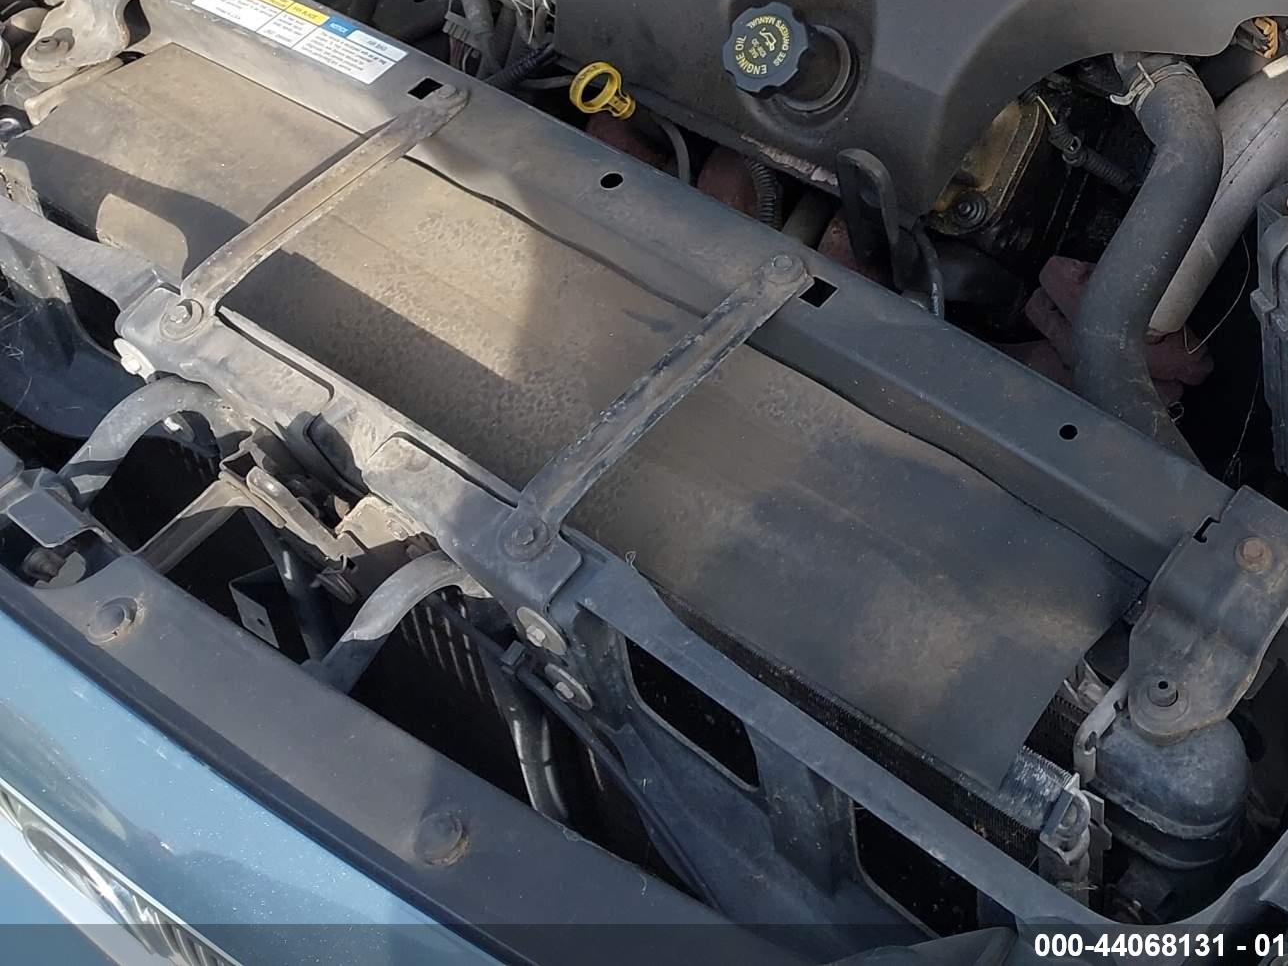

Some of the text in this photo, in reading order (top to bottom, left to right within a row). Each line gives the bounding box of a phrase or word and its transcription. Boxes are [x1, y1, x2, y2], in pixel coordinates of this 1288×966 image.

[746, 15, 776, 28] MANUAL
[735, 35, 768, 75] ENGINE OIL
[773, 52, 787, 67] SEE
